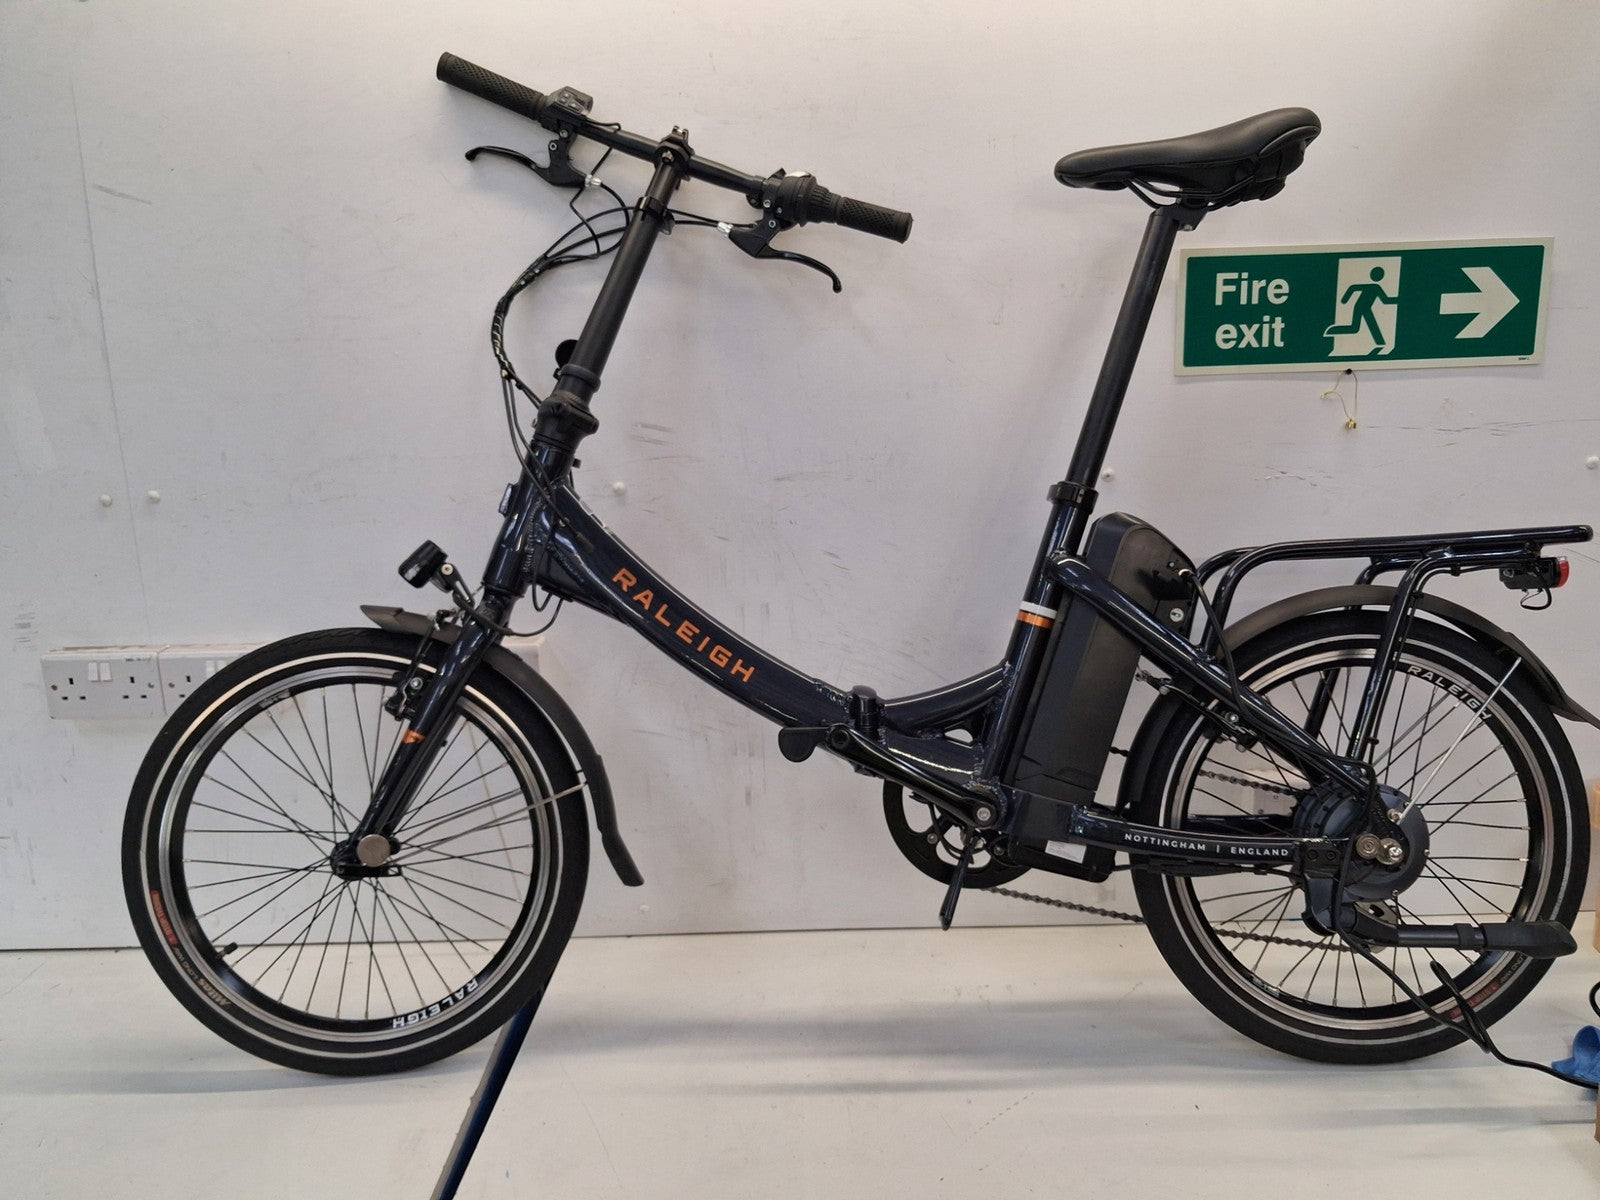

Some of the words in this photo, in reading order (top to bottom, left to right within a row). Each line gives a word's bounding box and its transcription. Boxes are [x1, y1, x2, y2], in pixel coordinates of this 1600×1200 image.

[1214, 271, 1290, 306] Fire
[1214, 315, 1286, 350] exit
[612, 567, 756, 683] RALEIGH
[1124, 833, 1206, 851] NOTTINGHAM
[1230, 846, 1289, 857] ENGLAND
[392, 977, 479, 1029] RALEIGH
